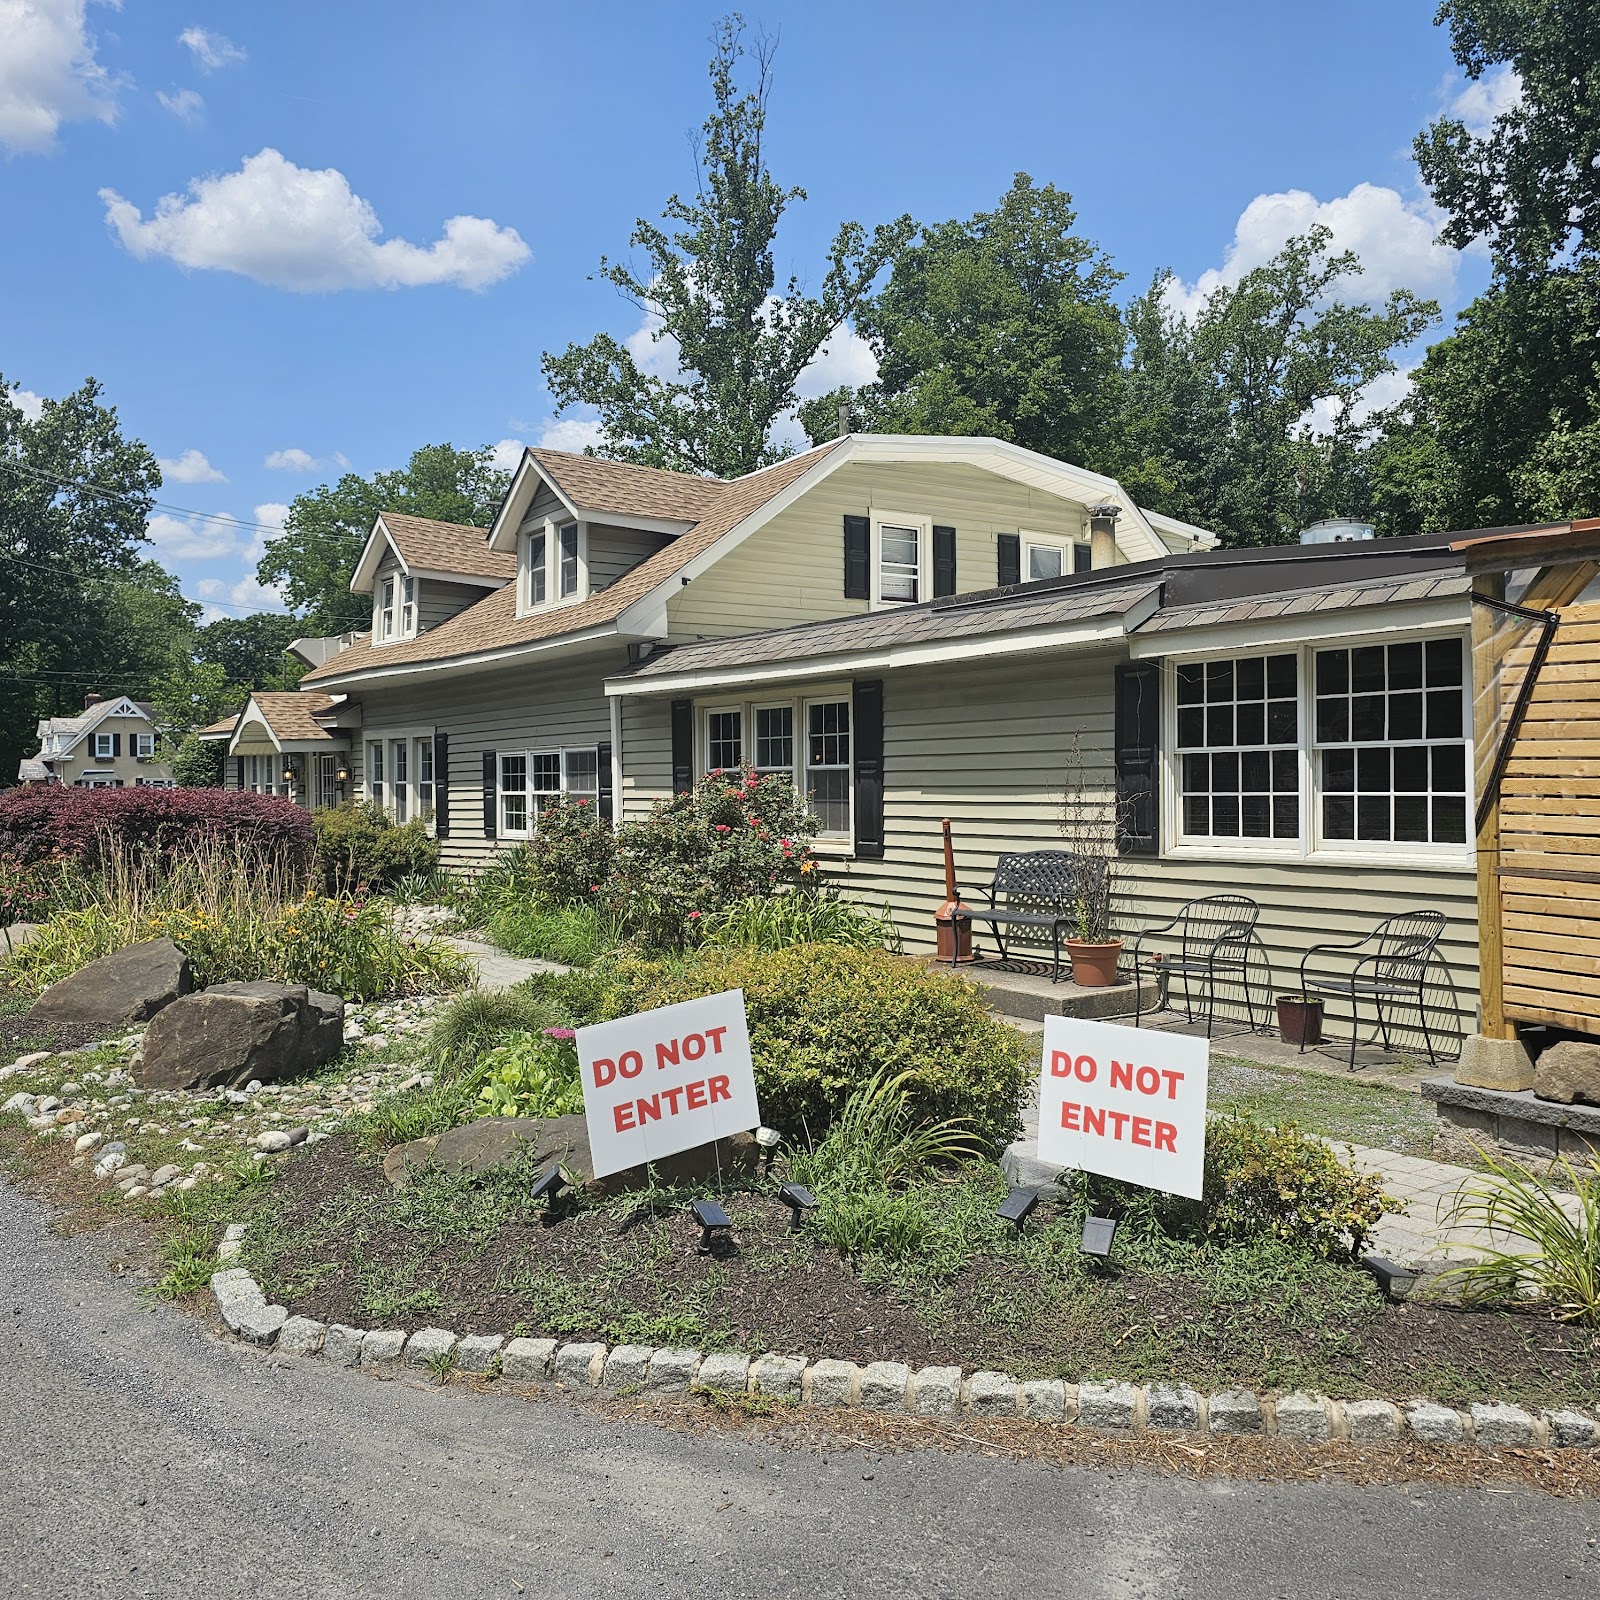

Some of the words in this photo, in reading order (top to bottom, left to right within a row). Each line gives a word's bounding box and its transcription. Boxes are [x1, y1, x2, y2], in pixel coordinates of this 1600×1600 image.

[592, 1050, 643, 1088] DO
[655, 1026, 727, 1070] NOT
[1051, 1050, 1097, 1082] DO
[1110, 1060, 1185, 1100] NOT
[613, 1074, 732, 1133] ENTER
[1061, 1101, 1177, 1153] ENTER
